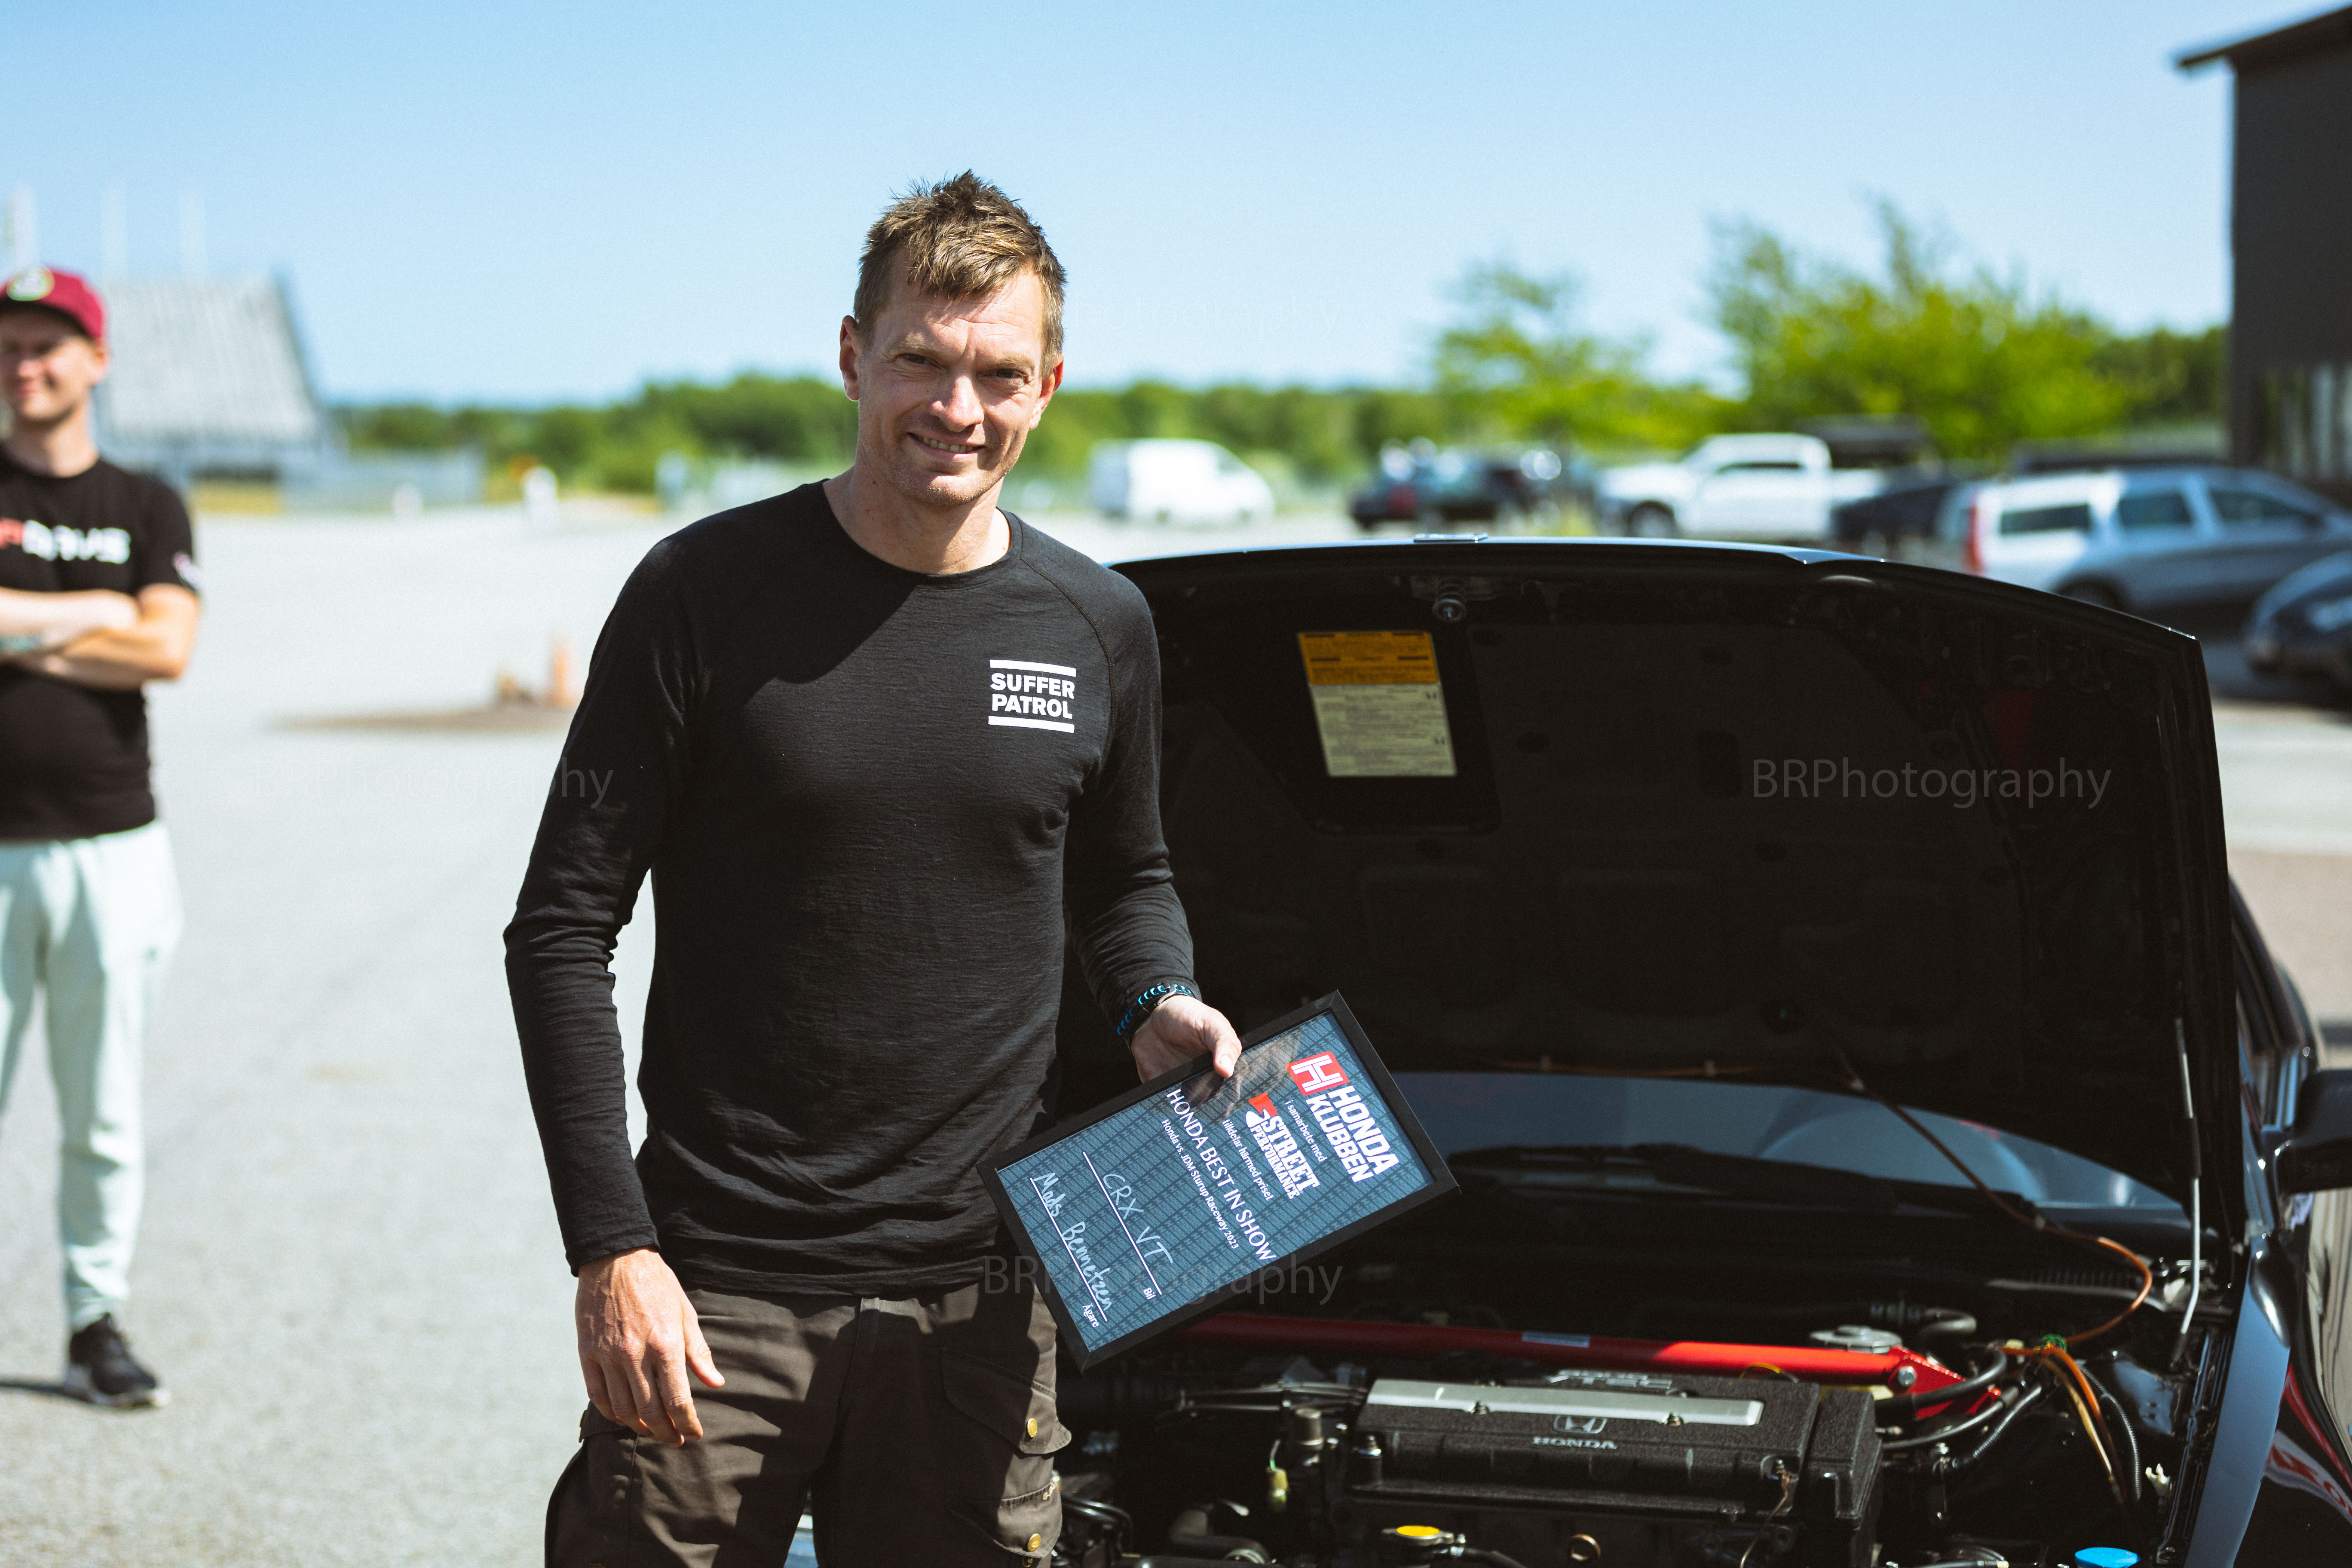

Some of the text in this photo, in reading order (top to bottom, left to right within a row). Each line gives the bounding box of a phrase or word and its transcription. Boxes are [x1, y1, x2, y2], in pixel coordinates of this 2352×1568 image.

[990, 673, 1075, 699] SUFFER
[992, 693, 1073, 719] PATROL
[1222, 1119, 1274, 1201] tilldelar härmed priset
[1250, 1124, 1300, 1199] PERFORMANCE
[1260, 1115, 1320, 1192] STREET
[1287, 1104, 1315, 1145] samarbete
[1311, 1142, 1328, 1162] med
[1305, 1094, 1374, 1182] KLUBBEN
[1327, 1085, 1399, 1175] HONDA
[1033, 1172, 1066, 1217] Mads
[1161, 1119, 1239, 1249] Honda vs. JDM Sturup Raceway 2023
[1166, 1089, 1277, 1260] HONDA BEST IN SHOW
[1103, 1173, 1173, 1264] CRX VT
[1082, 1303, 1099, 1328] Ägare
[1143, 1287, 1156, 1300] Bil
[1532, 1436, 1618, 1450] HONDA
